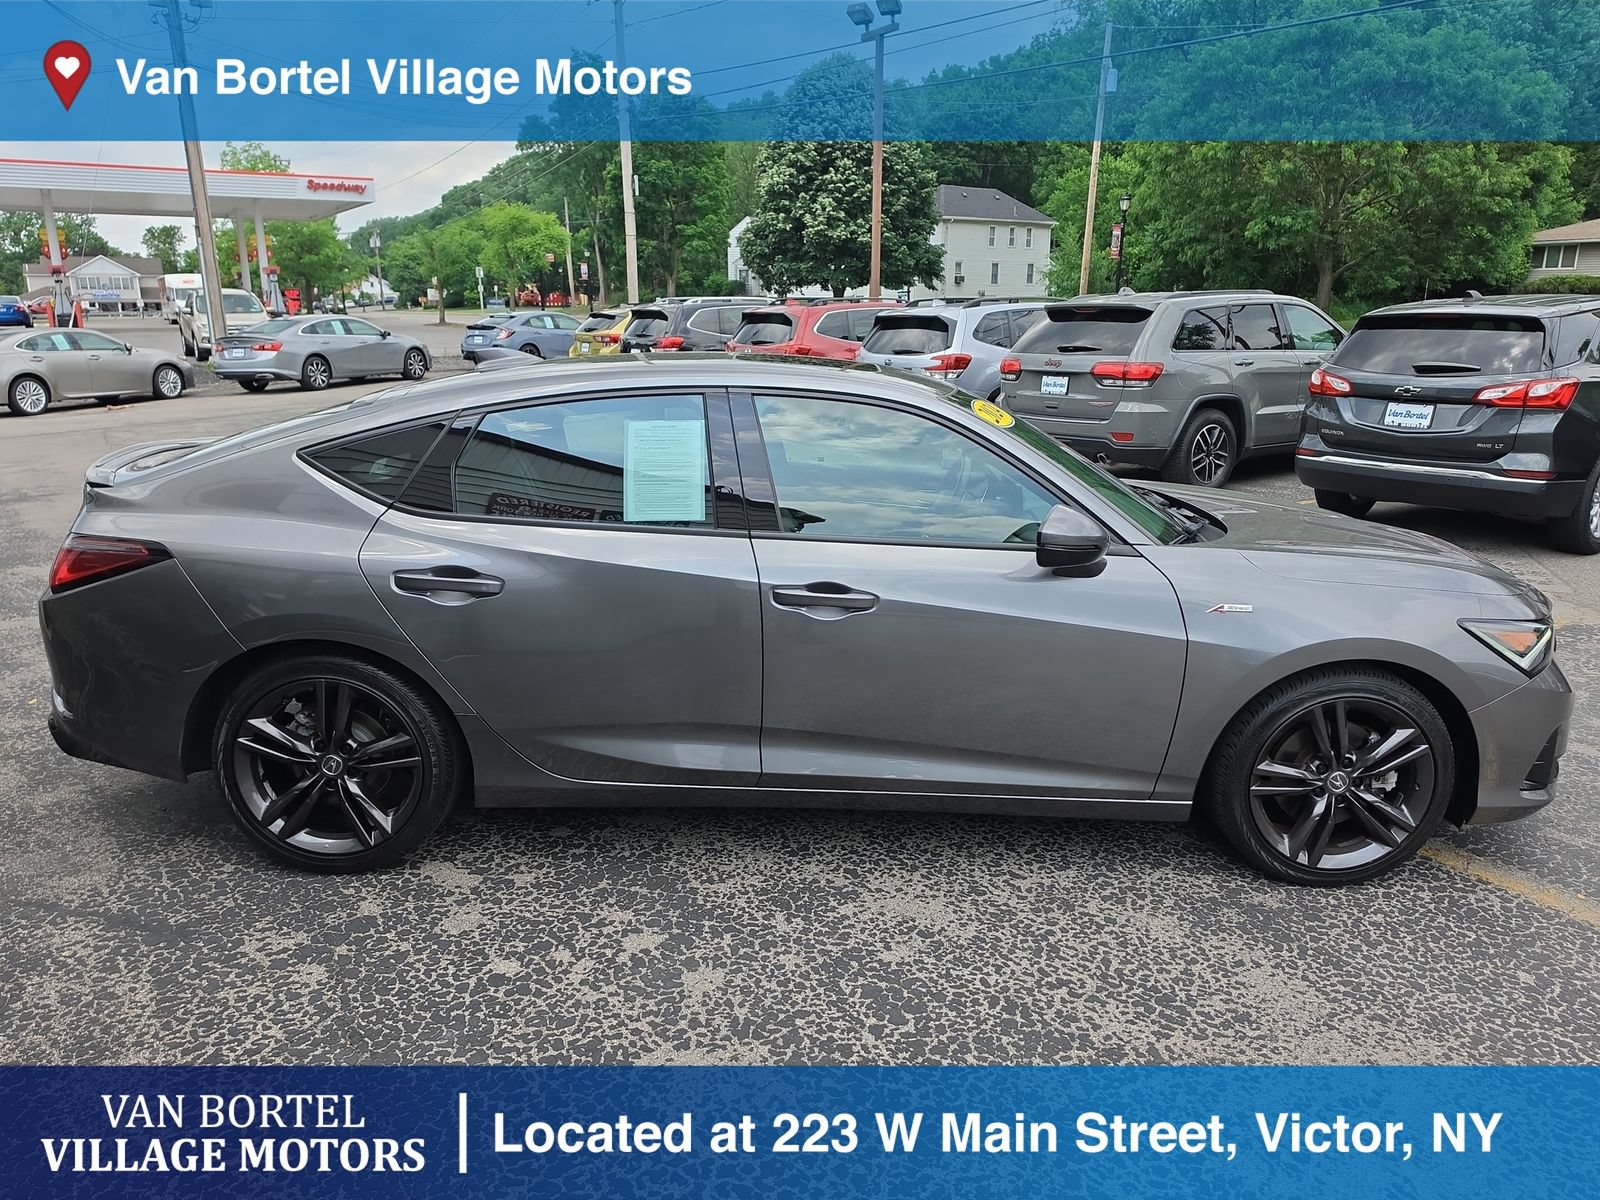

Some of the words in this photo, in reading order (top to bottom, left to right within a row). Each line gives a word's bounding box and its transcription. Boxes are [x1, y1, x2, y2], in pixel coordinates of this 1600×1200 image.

[306, 179, 367, 195] Speedway
[1044, 358, 1063, 368] Jeep
[1388, 408, 1404, 418] Van
[1403, 409, 1430, 420] Bortel
